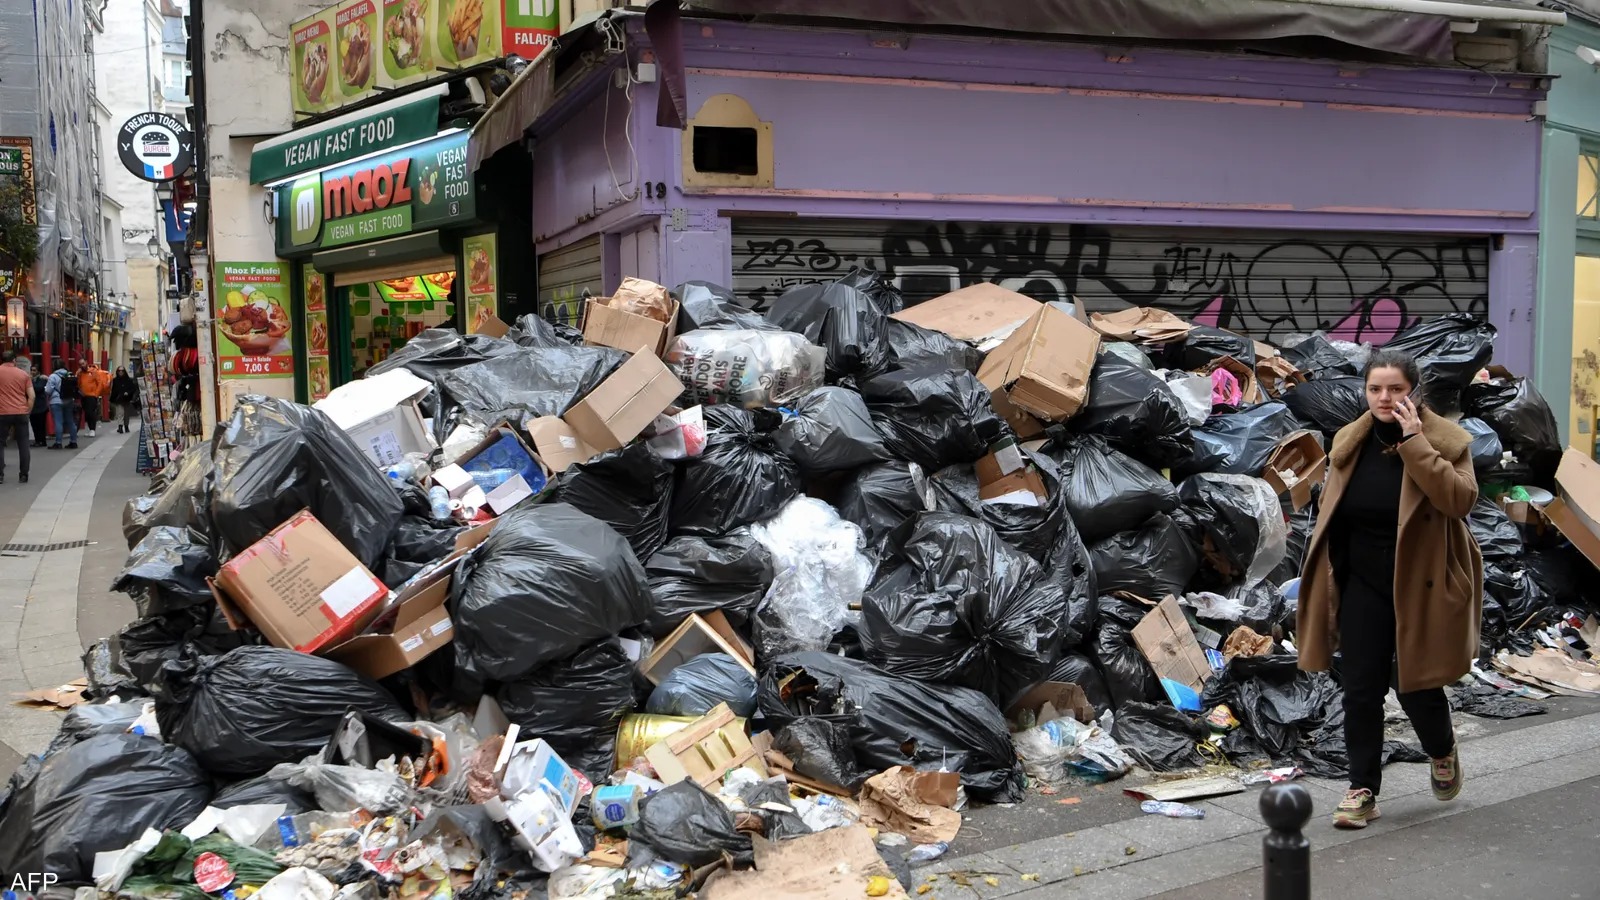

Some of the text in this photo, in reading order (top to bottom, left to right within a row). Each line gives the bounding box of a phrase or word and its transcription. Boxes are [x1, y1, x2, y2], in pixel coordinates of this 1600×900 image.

[124, 113, 185, 135] FRENCH TOQUE
[143, 145, 170, 153] BURGER
[285, 116, 395, 168] VEGAN FAST FOOD
[436, 145, 467, 167] VEGAN
[445, 163, 467, 182] FAST
[324, 158, 412, 220] maoz
[444, 180, 469, 199] FOOD
[644, 181, 667, 199] 19
[330, 213, 403, 239] VEGAN FAST FOOD
[224, 266, 249, 274] Maoz
[244, 363, 270, 373] 7,00 €
[713, 360, 728, 396] PARIS
[728, 356, 747, 403] PROPRE
